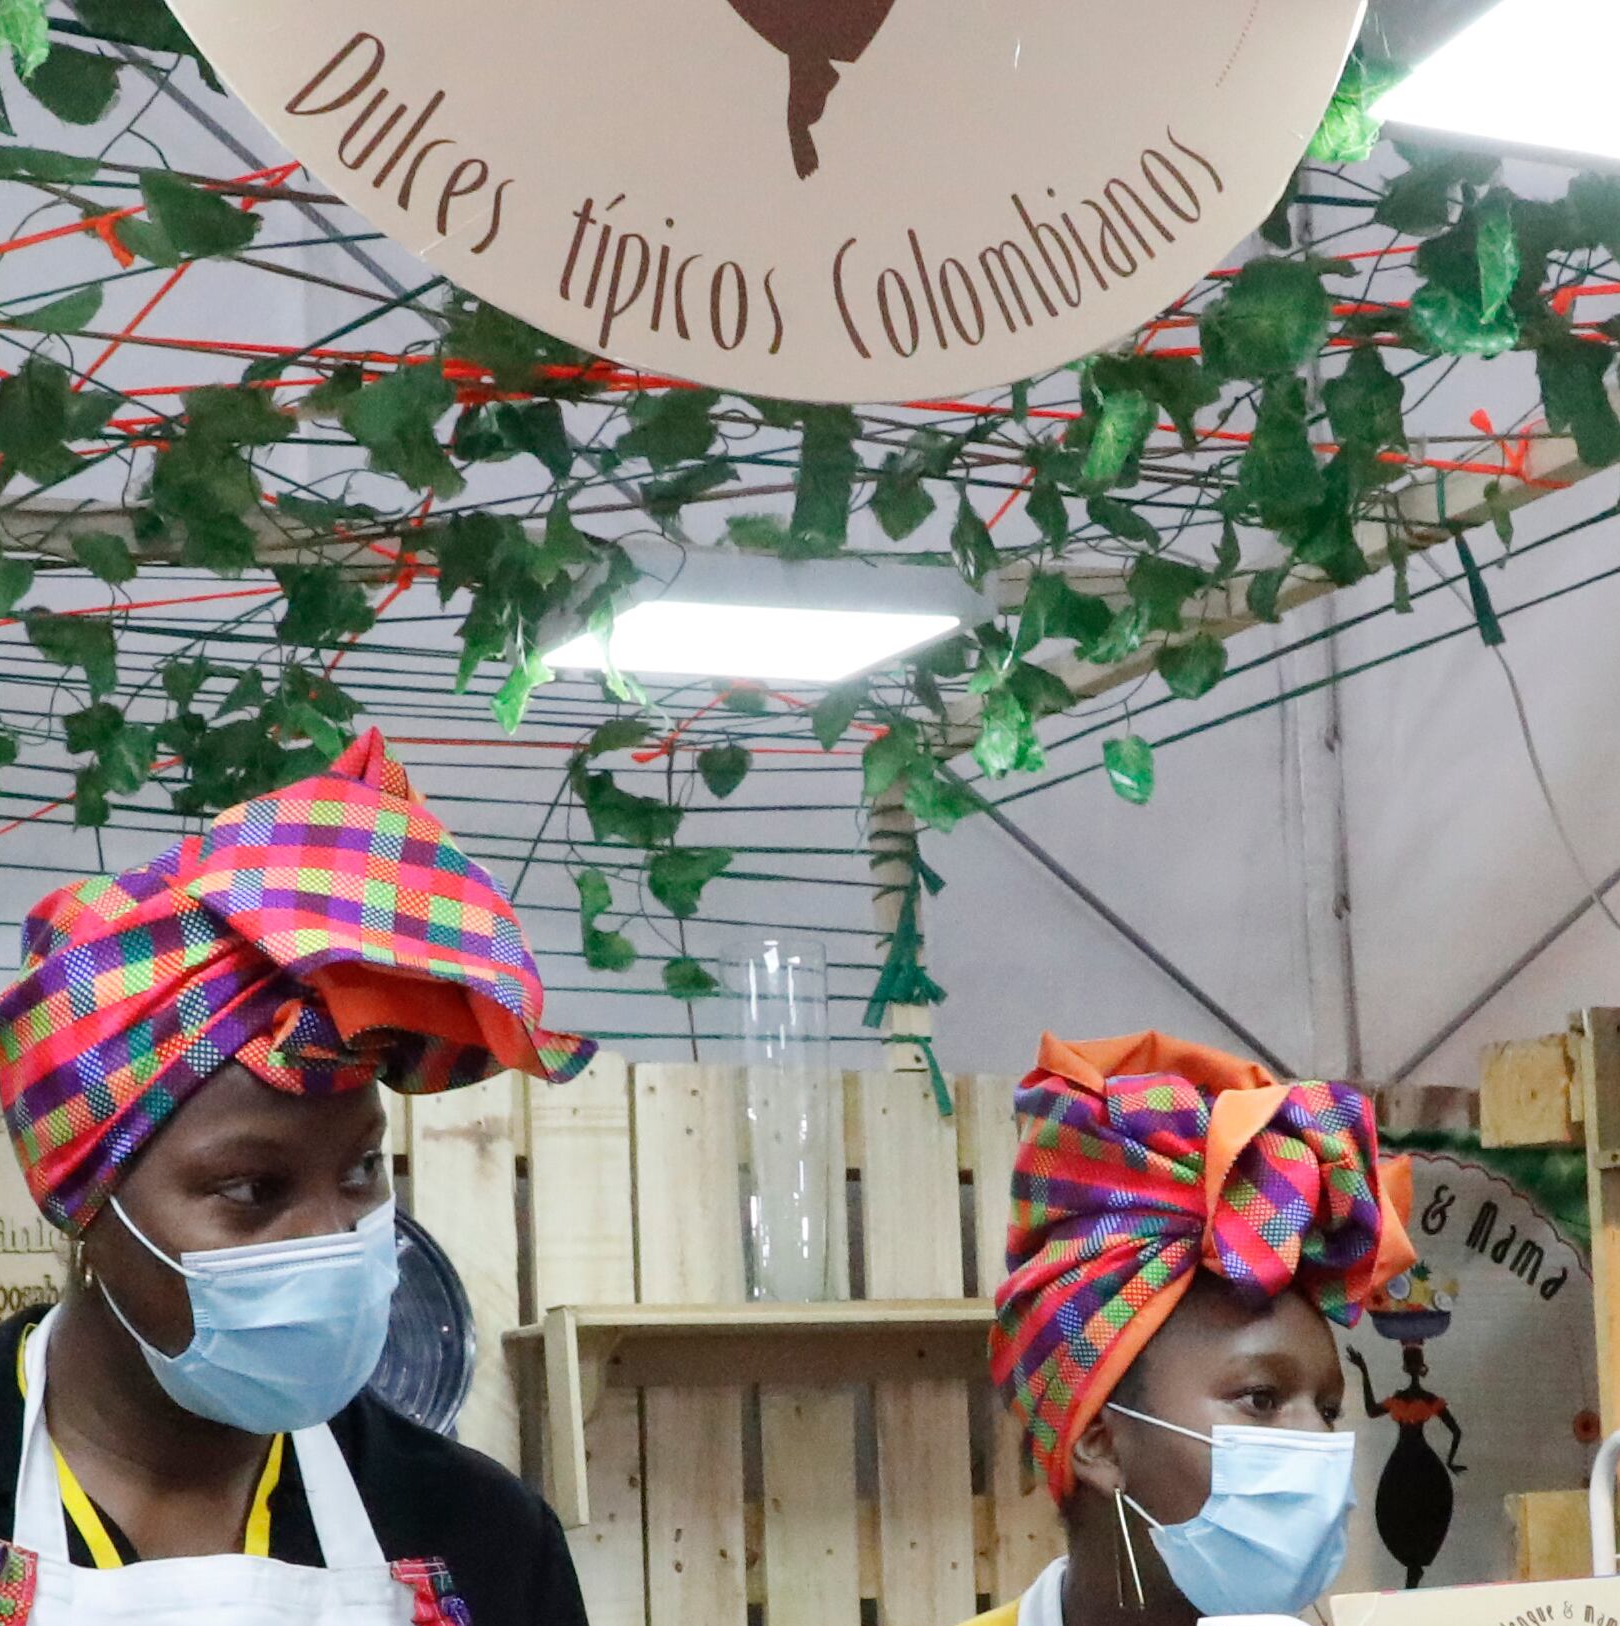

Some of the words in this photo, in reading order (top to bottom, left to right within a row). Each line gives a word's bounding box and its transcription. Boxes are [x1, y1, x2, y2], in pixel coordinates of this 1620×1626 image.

[284, 31, 514, 256] Dulces
[558, 193, 783, 355] típicos
[833, 125, 1224, 361] Colombianos
[1421, 1184, 1456, 1235] &
[1466, 1200, 1568, 1301] Mama
[1563, 1600, 1574, 1620] &
